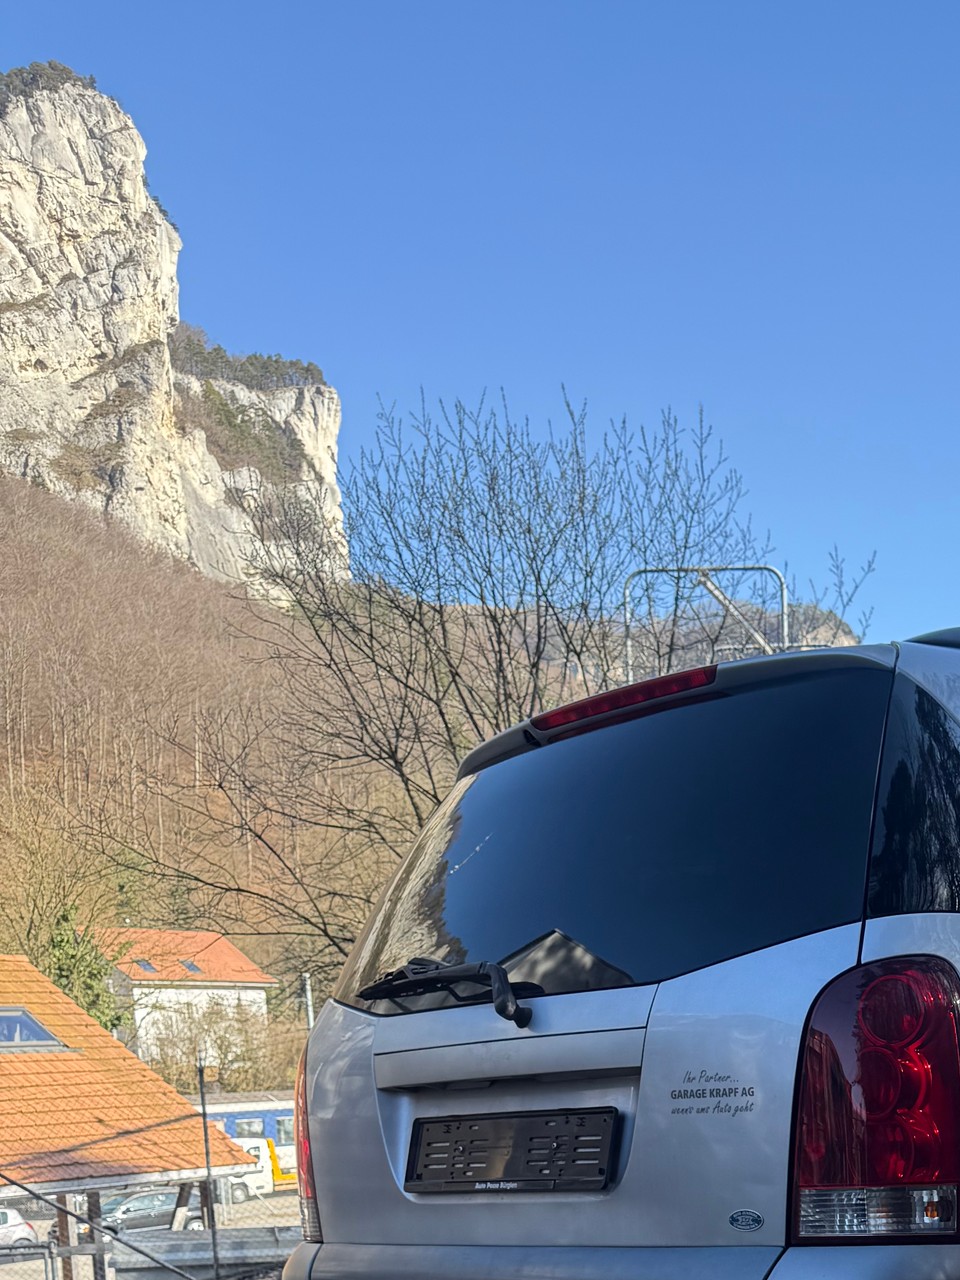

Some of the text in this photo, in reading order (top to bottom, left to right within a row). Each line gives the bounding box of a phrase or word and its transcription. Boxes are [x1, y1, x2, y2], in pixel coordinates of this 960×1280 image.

[682, 1069, 739, 1084] Ihr Partner...
[671, 1087, 755, 1100] GARAGE KRAPF AG
[696, 1106, 710, 1114] ums
[712, 1100, 732, 1114] Auto
[732, 1100, 754, 1117] geht
